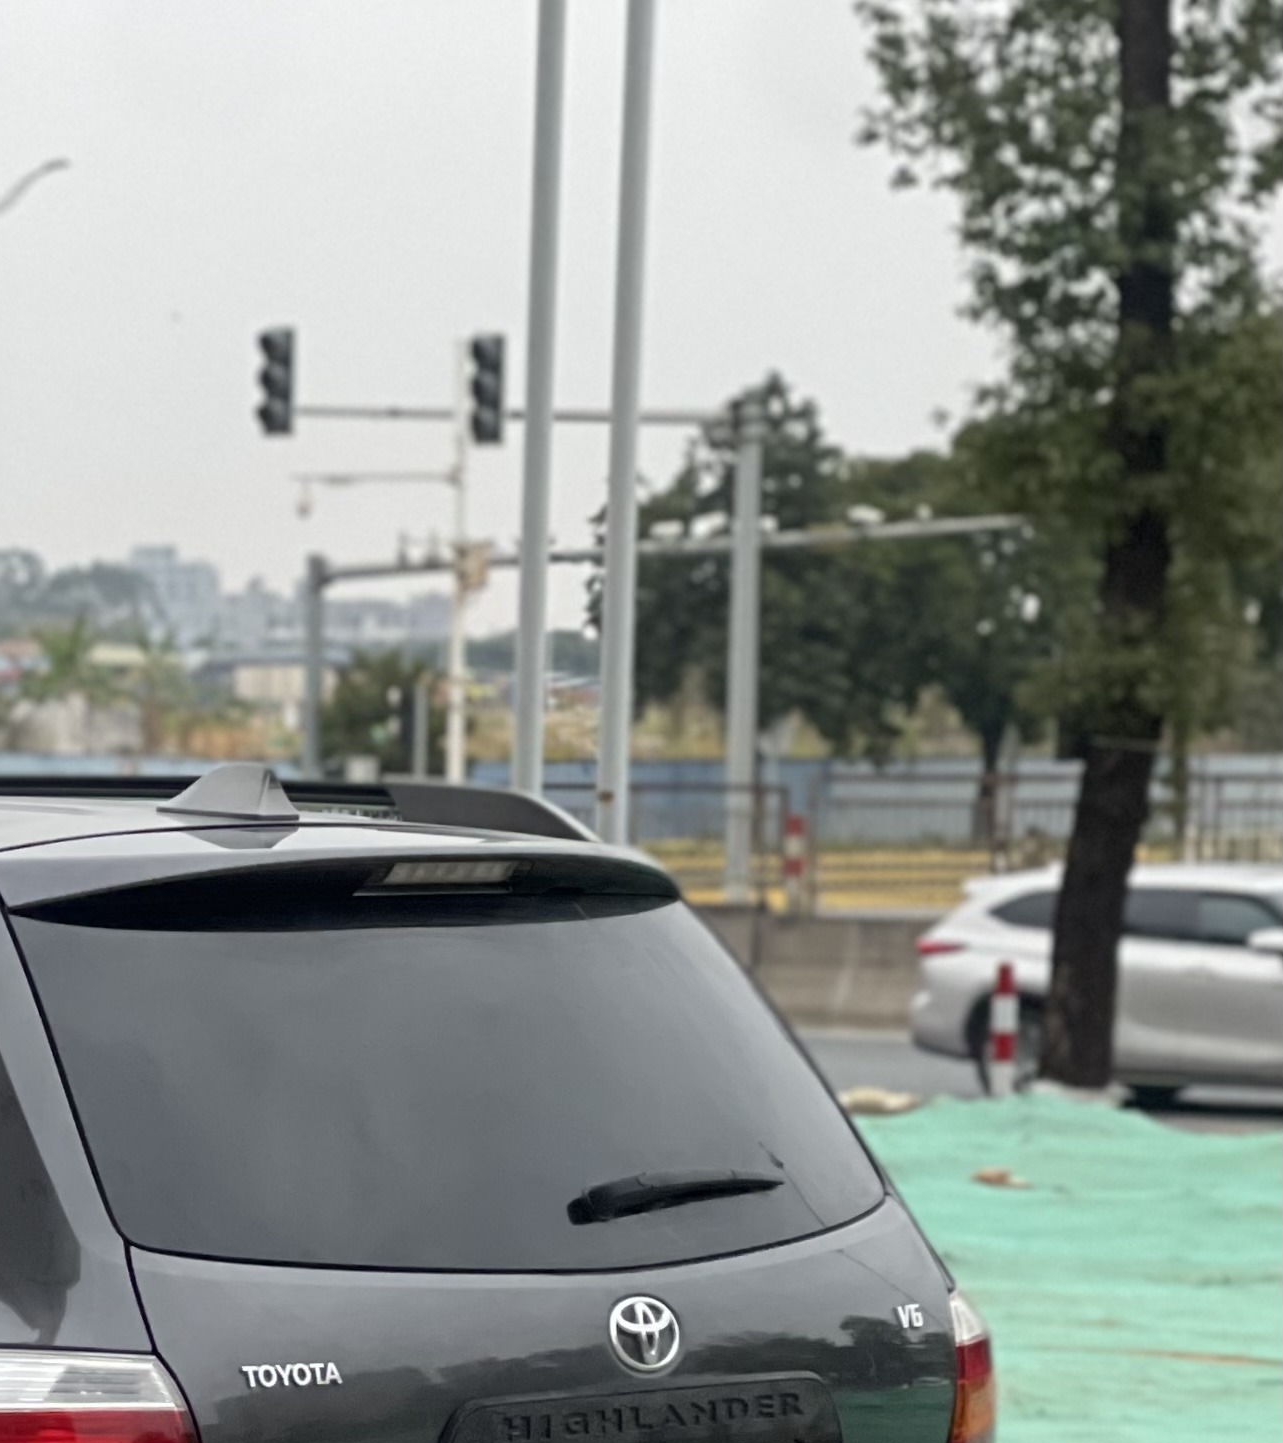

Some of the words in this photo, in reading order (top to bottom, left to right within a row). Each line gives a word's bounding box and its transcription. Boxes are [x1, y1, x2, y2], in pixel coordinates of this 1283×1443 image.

[896, 1303, 924, 1329] V6
[241, 1362, 343, 1388] TOYOTA
[502, 1392, 805, 1442] HIGHLANDER
